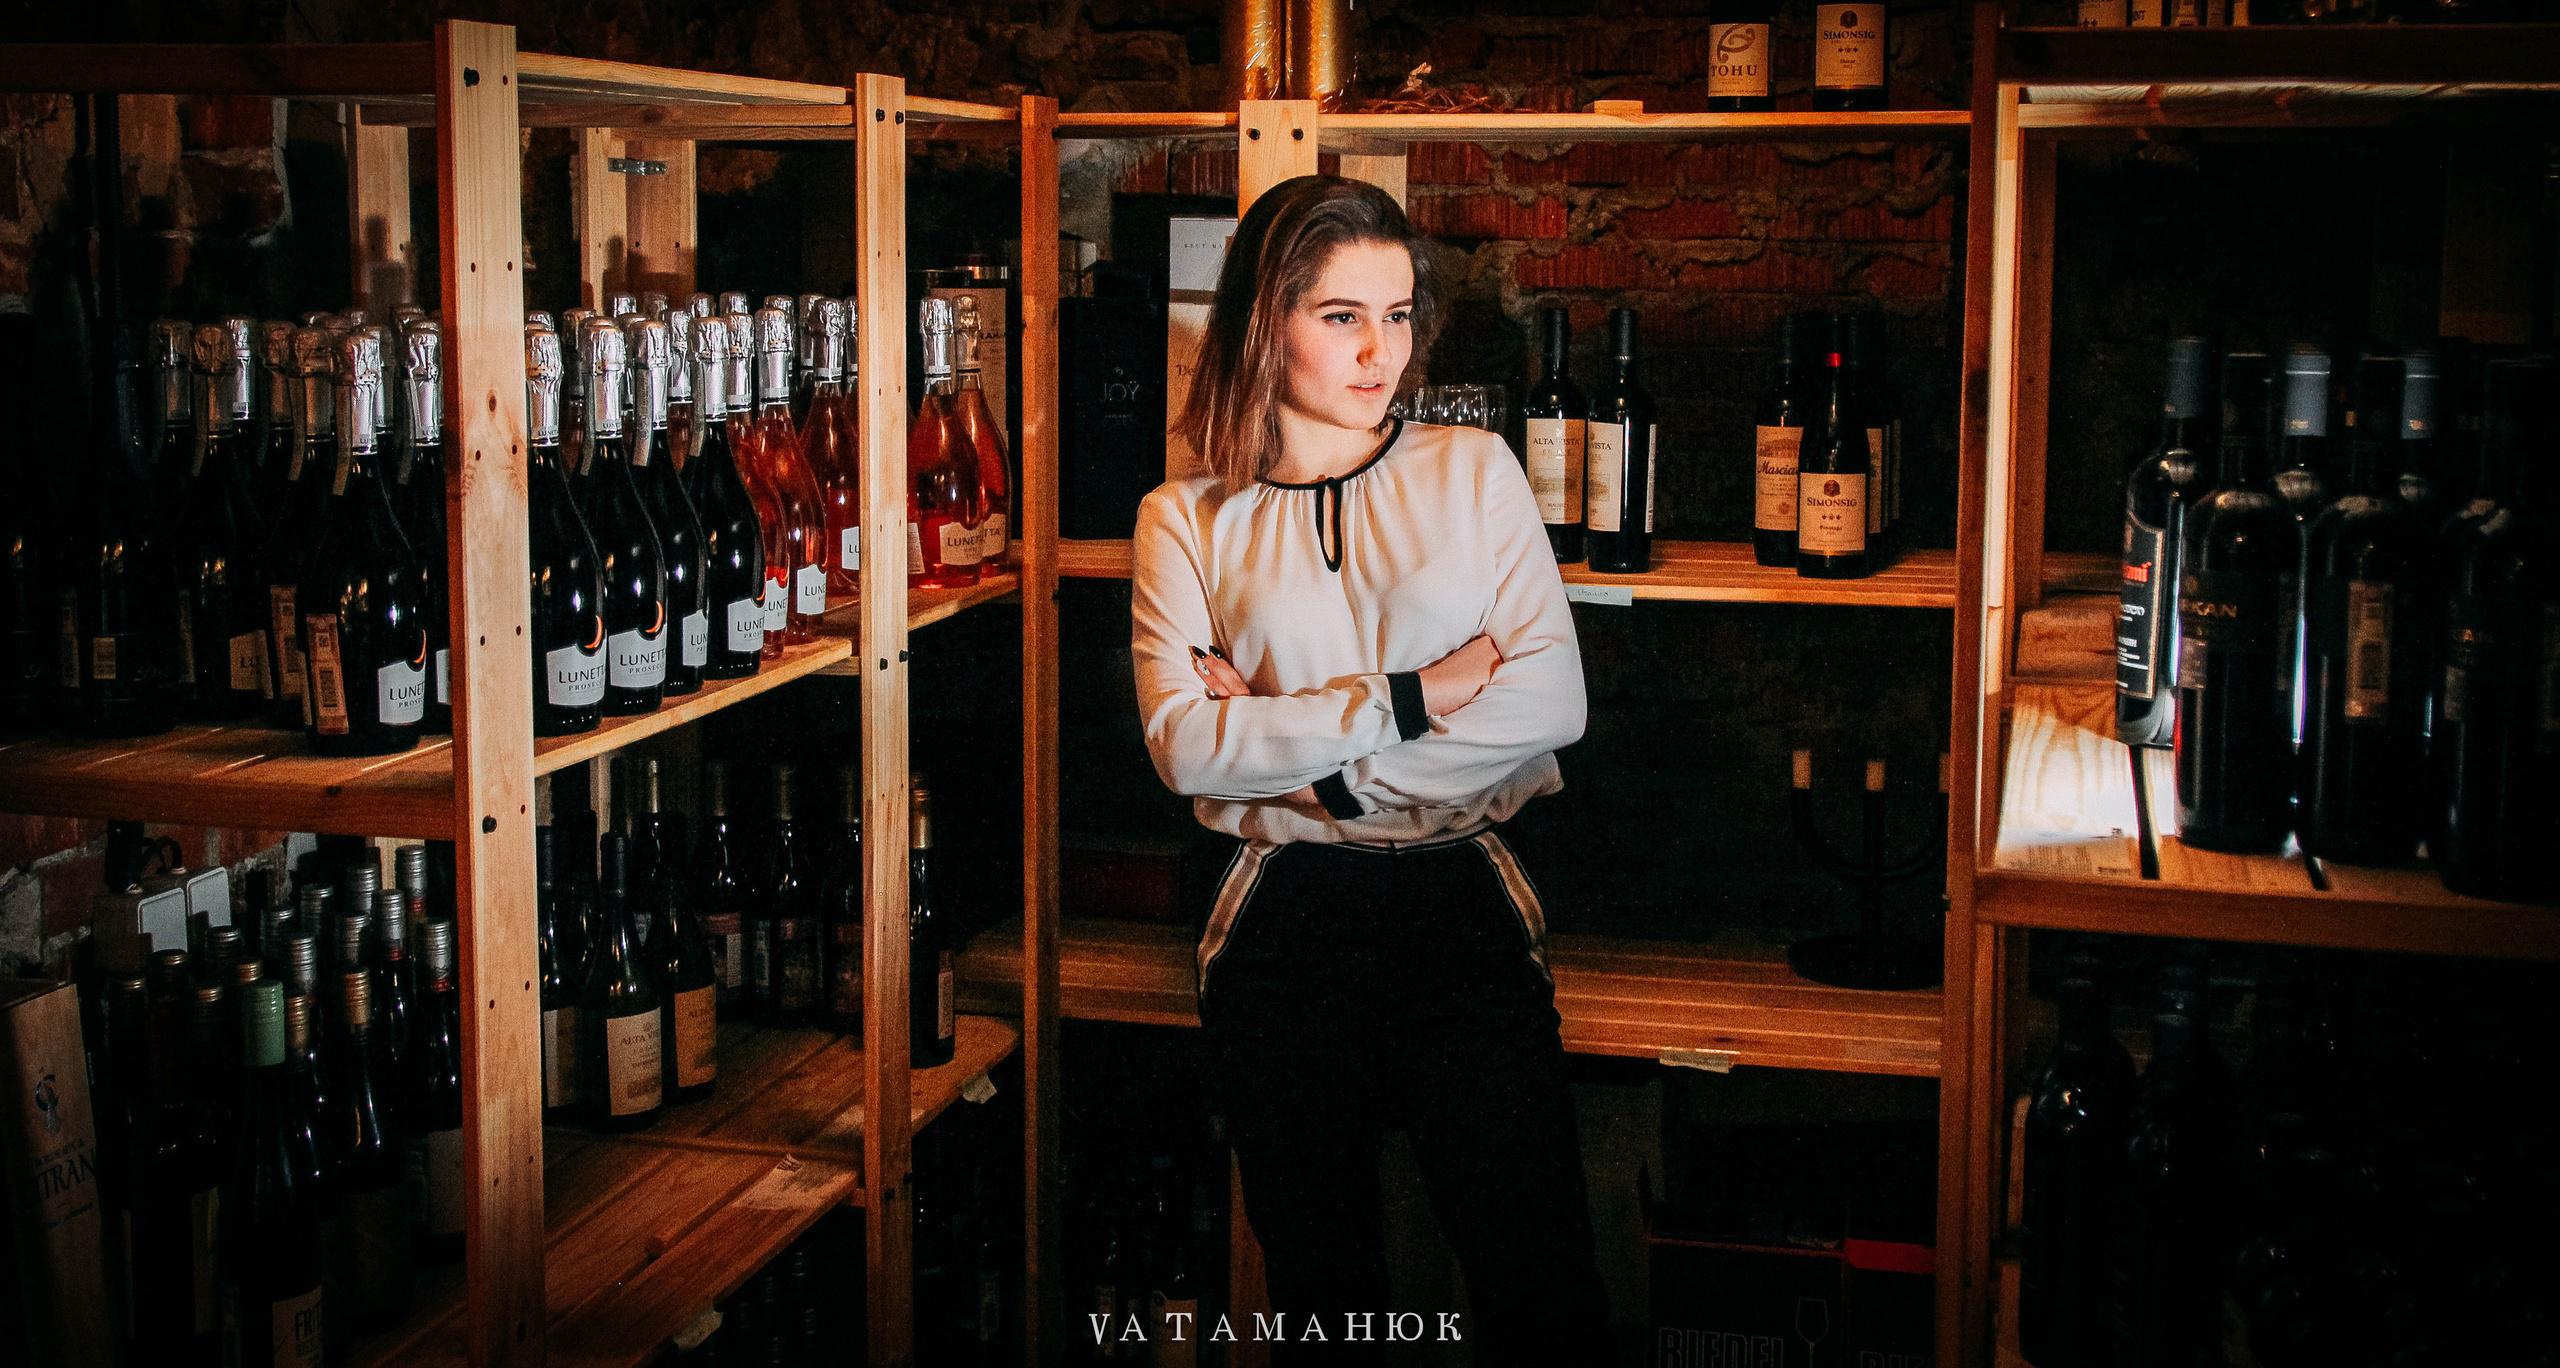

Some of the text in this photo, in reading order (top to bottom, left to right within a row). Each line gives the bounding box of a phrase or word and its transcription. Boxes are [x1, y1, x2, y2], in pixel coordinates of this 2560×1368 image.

[1823, 30, 1876, 40] SIMONSIG
[1710, 64, 1758, 77] TOHU
[1533, 437, 1554, 446] ALTA
[1758, 460, 1799, 475] Mascia
[1807, 497, 1857, 507] SIMONSIG
